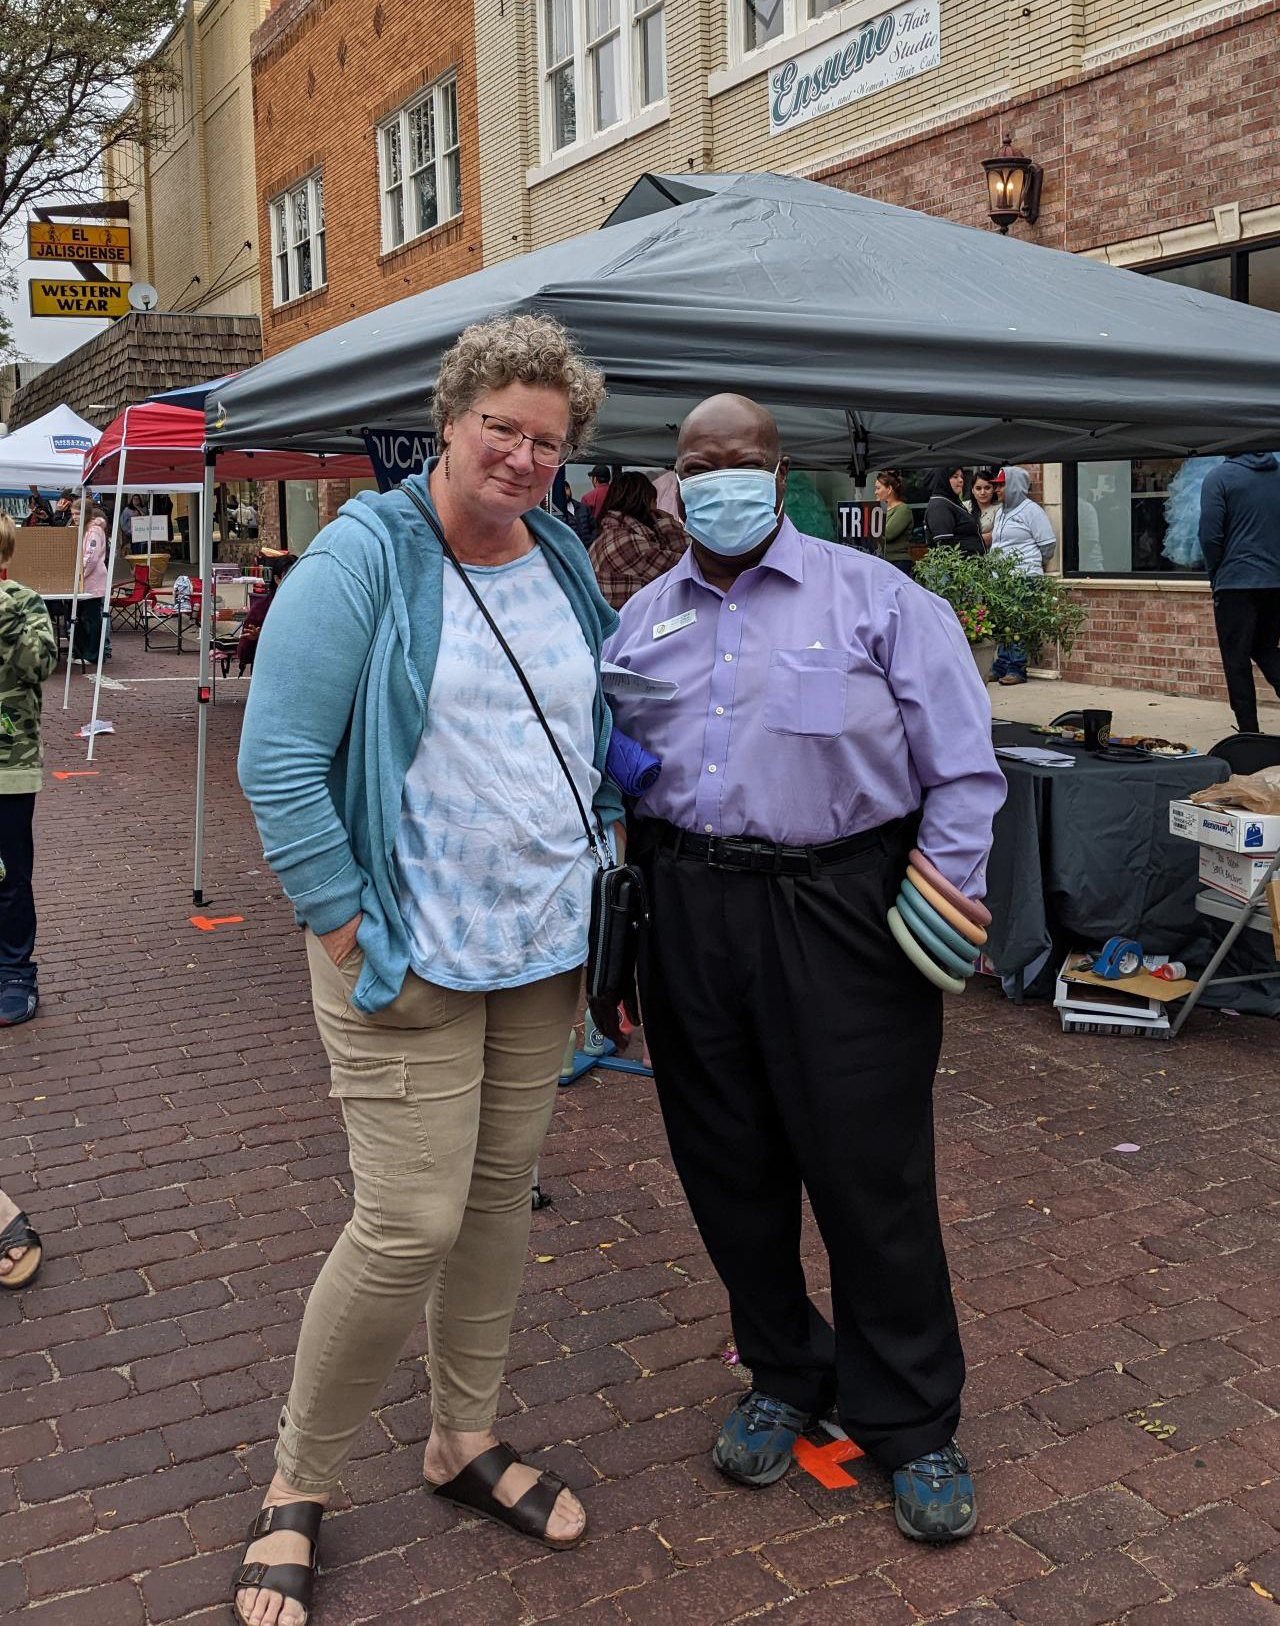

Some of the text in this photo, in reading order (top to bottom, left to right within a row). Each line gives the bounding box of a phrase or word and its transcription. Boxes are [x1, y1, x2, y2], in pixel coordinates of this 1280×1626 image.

[896, 7, 930, 36] Hair
[889, 31, 938, 64] Studio
[894, 64, 915, 81] Hair
[72, 229, 88, 241] EL
[37, 245, 125, 260] JALISCIENSE
[41, 285, 121, 298] WESTERN
[56, 299, 108, 311] WEAR
[839, 506, 884, 538] TRIO
